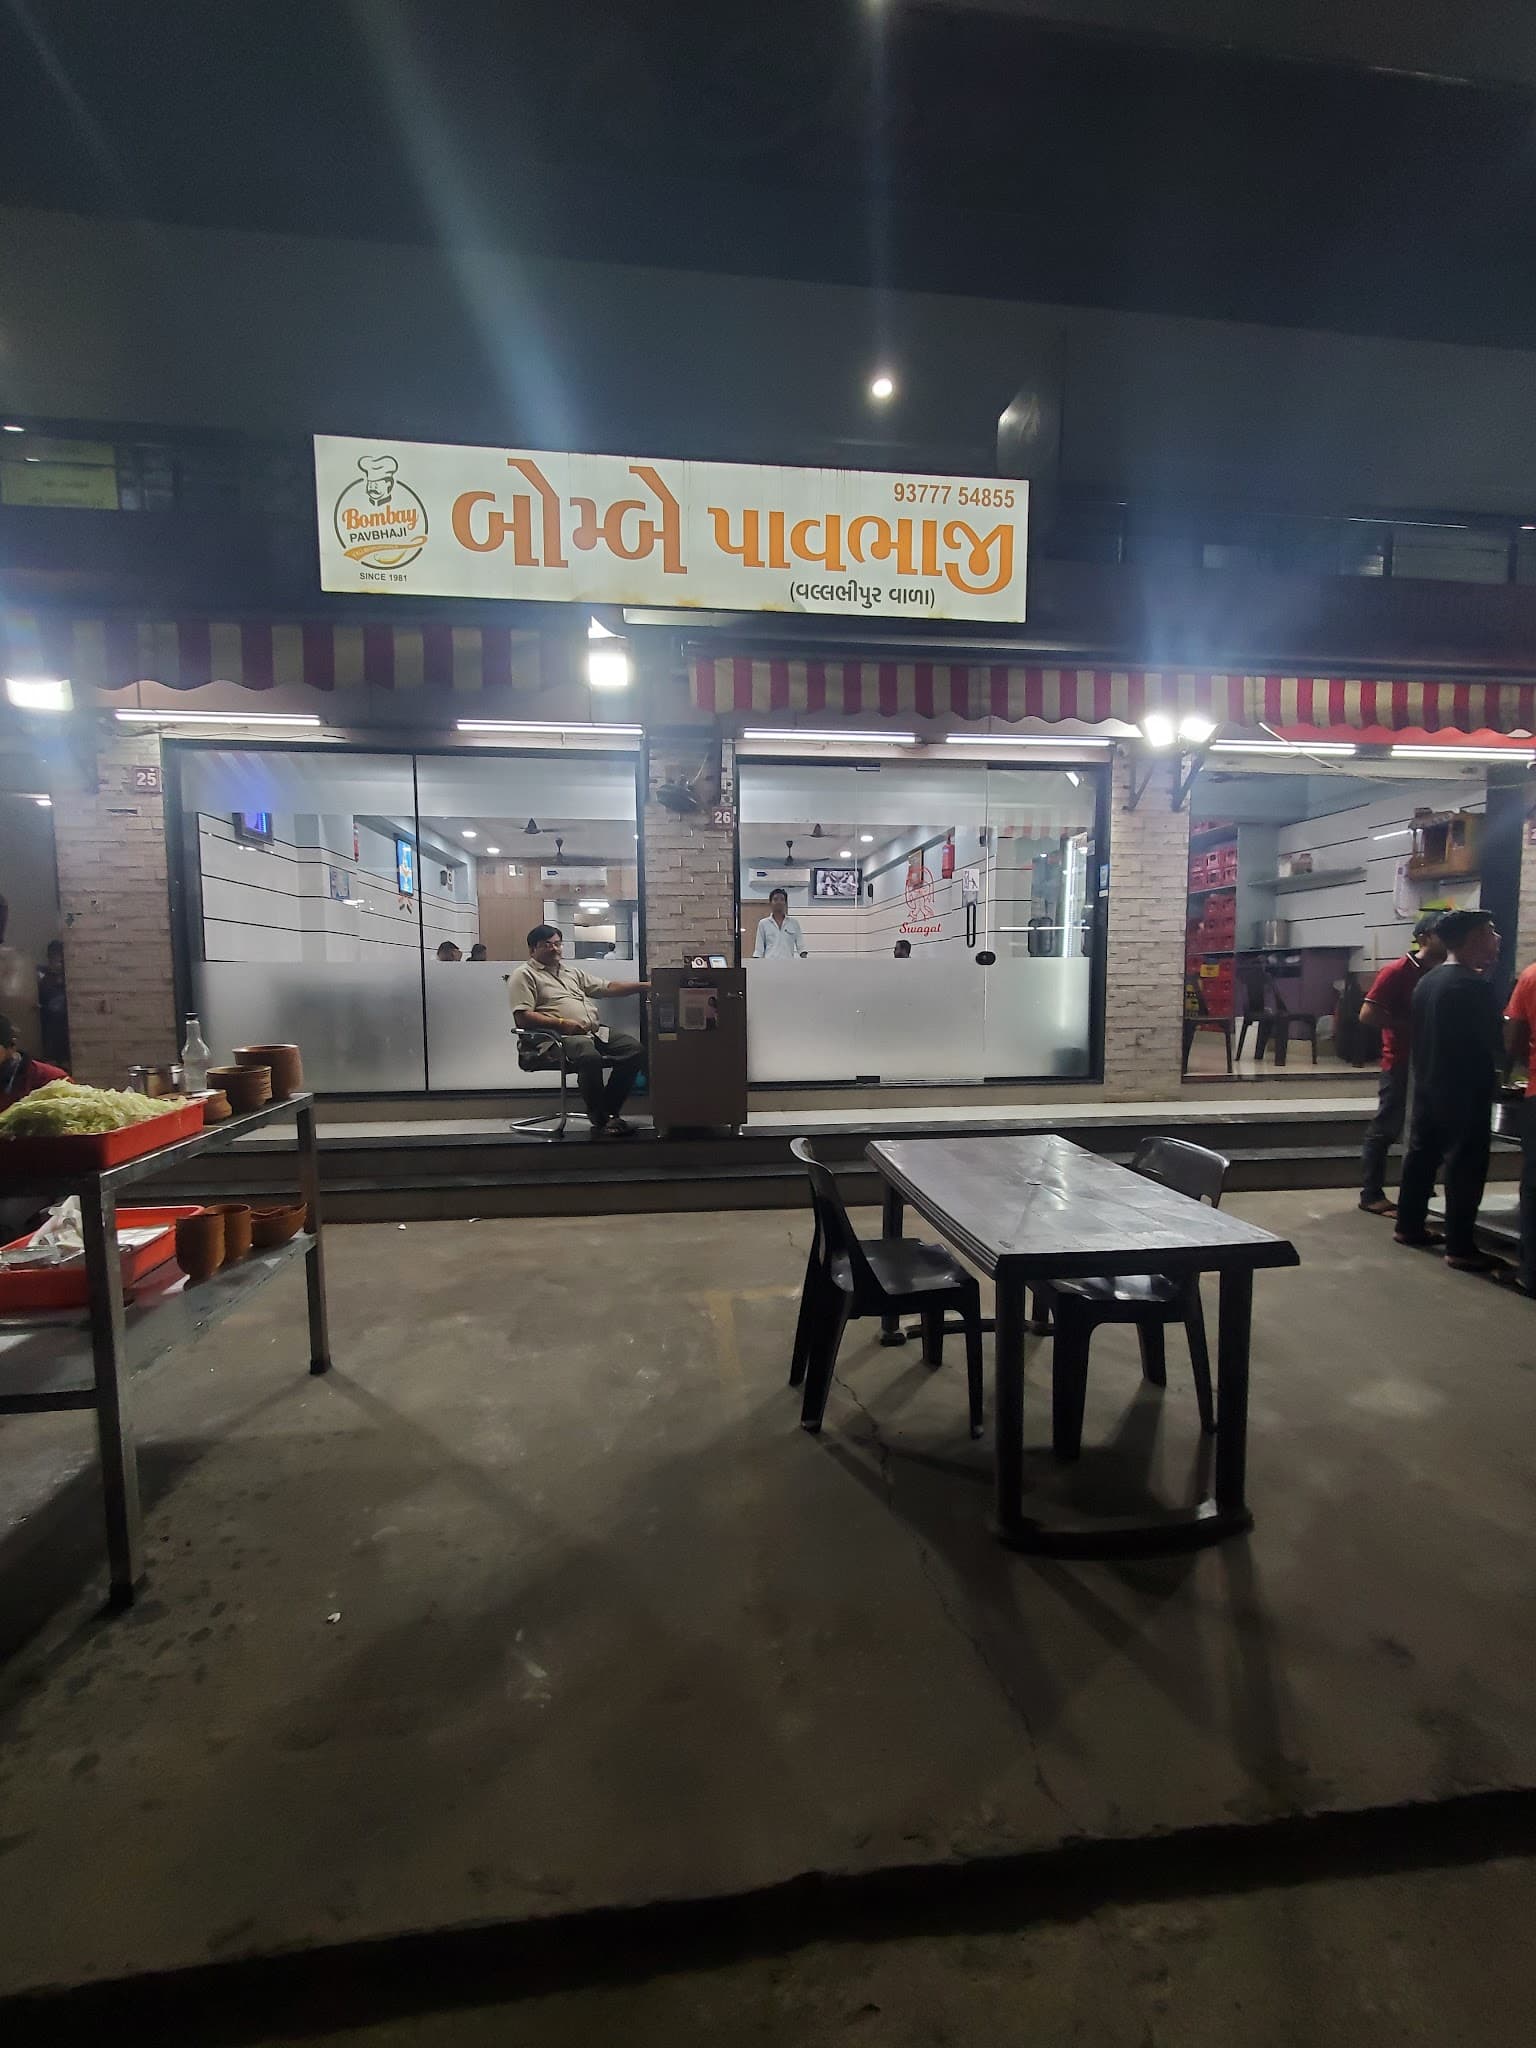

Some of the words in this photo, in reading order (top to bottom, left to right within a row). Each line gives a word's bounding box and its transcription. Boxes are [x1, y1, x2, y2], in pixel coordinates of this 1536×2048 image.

[894, 482, 952, 504] 93777
[958, 486, 1015, 508] 54855
[342, 504, 419, 531] Bombay
[451, 457, 688, 575] બોમ્બે
[707, 506, 1014, 595] પાવભાજી
[349, 527, 408, 543] PAVBHAJI
[359, 572, 387, 581] SINCE
[389, 574, 408, 582] 1981
[888, 588, 936, 609] વાળા)
[136, 772, 157, 786] 25
[714, 811, 731, 824] 26
